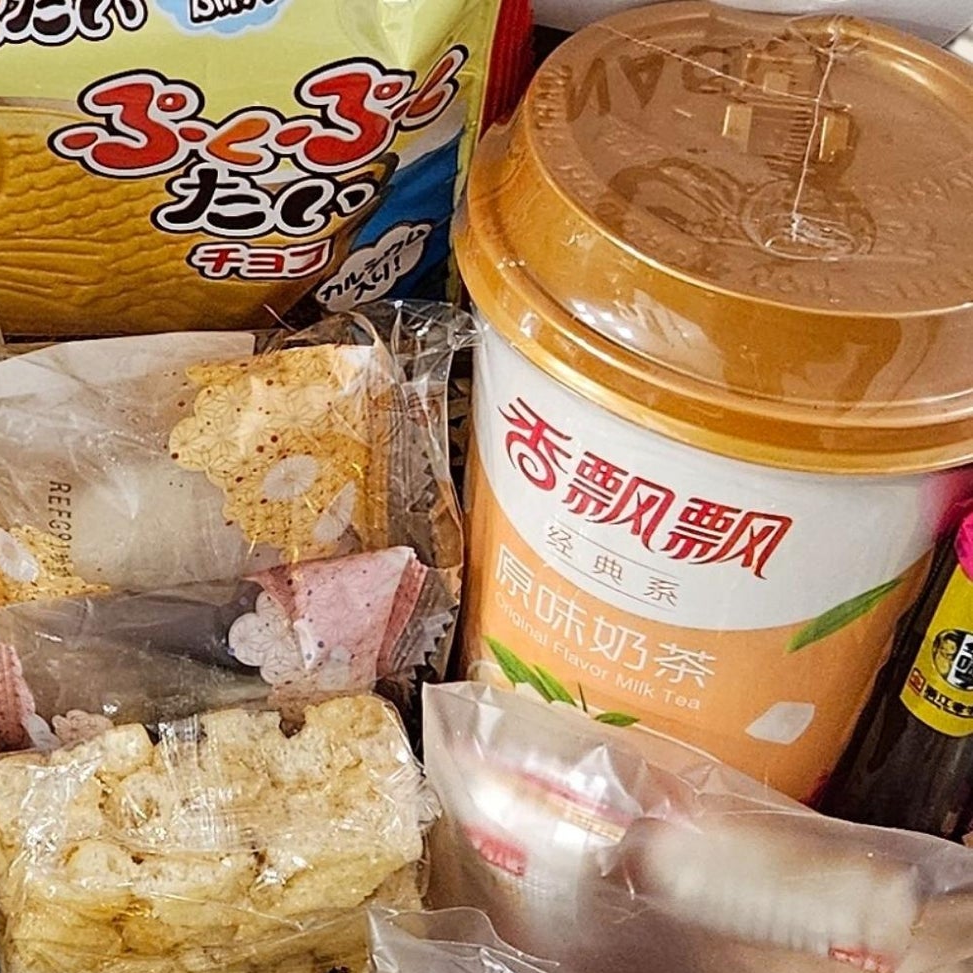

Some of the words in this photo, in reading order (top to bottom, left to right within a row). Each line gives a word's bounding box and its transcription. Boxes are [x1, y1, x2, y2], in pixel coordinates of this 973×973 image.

[497, 396, 795, 580] 香飘飘
[495, 543, 717, 689] 原味奶茶
[545, 525, 681, 607] 经典系
[495, 592, 549, 647] Original
[552, 640, 609, 680] Flavor
[615, 672, 656, 699] Milk
[663, 689, 702, 711] Tea
